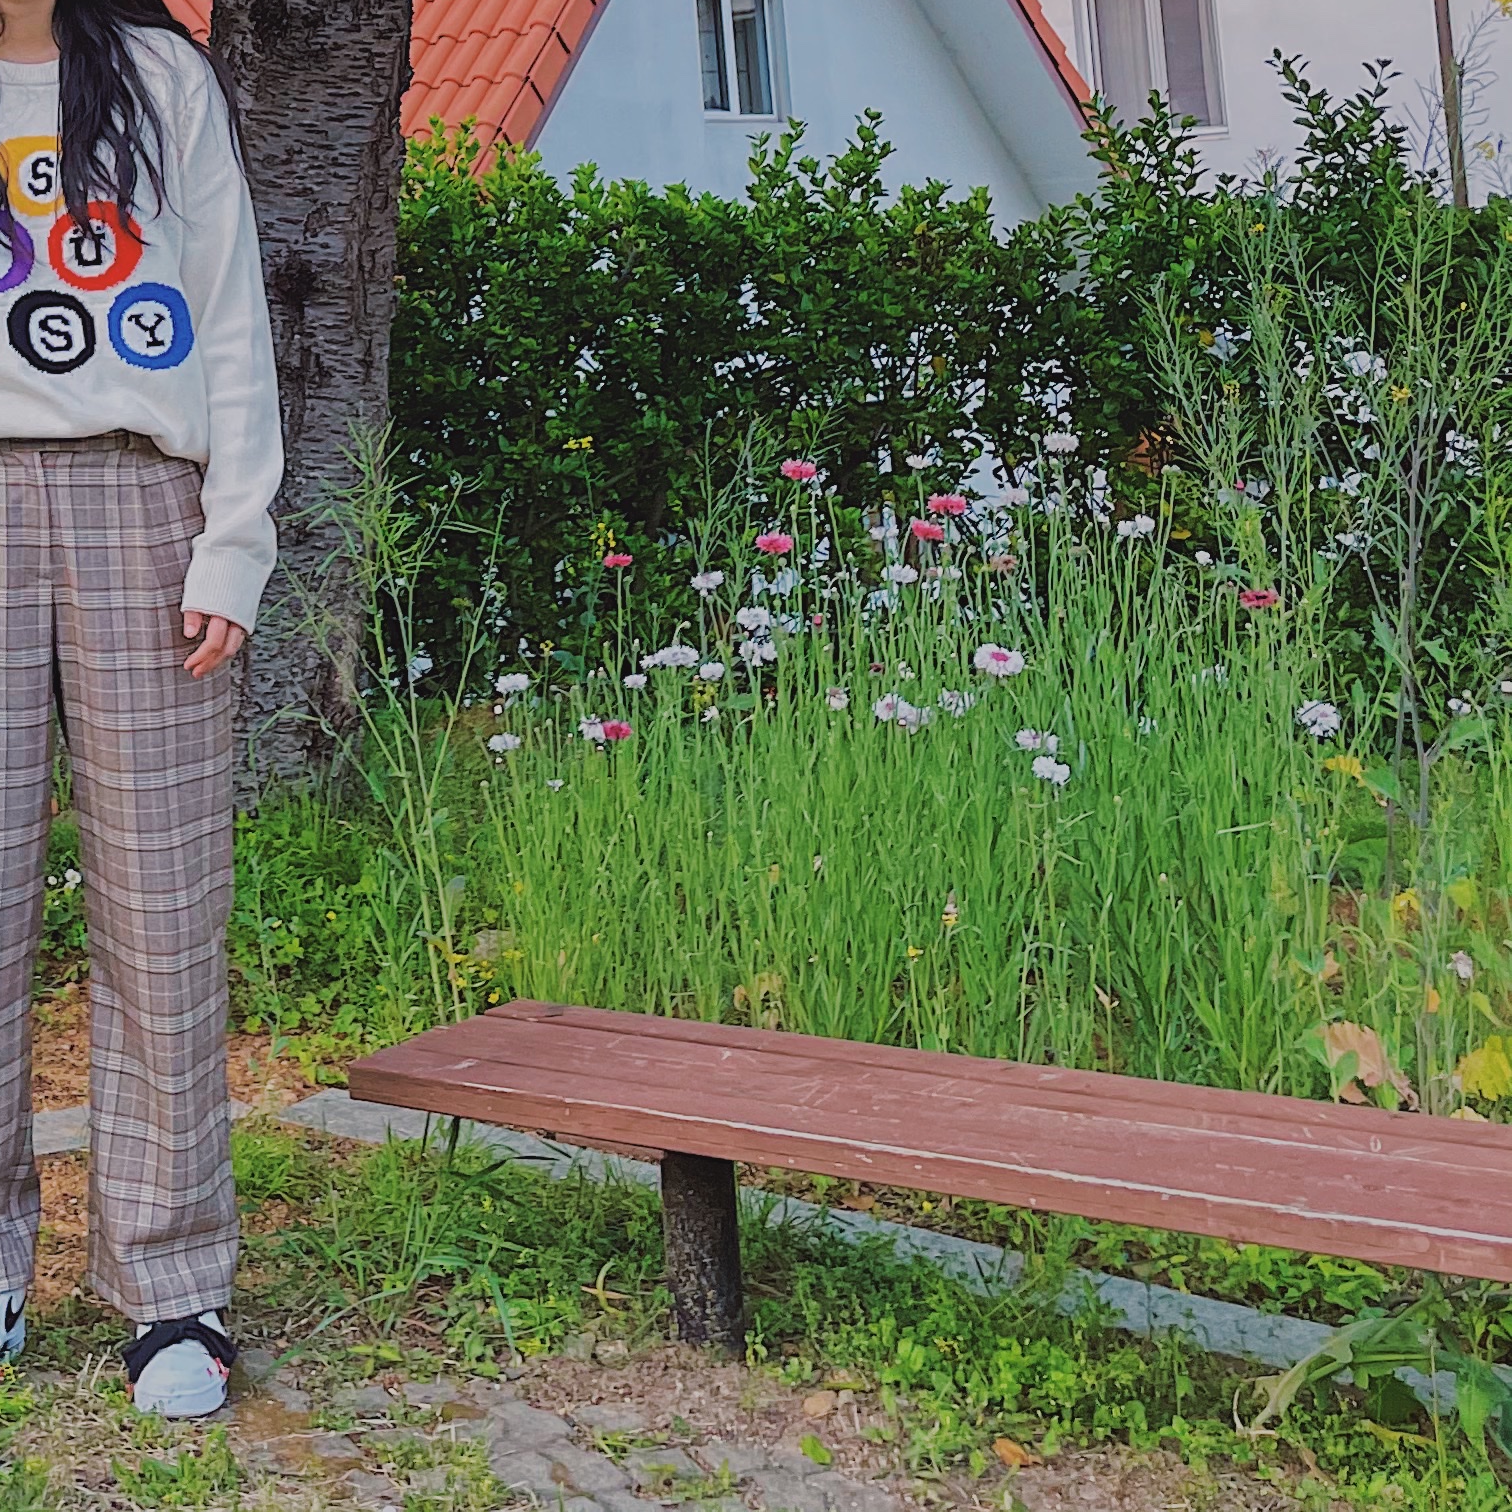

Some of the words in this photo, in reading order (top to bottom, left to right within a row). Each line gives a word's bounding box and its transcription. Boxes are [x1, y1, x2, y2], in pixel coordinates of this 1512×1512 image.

[28, 156, 54, 197] S
[39, 314, 73, 352] S
[127, 313, 166, 348] Y
